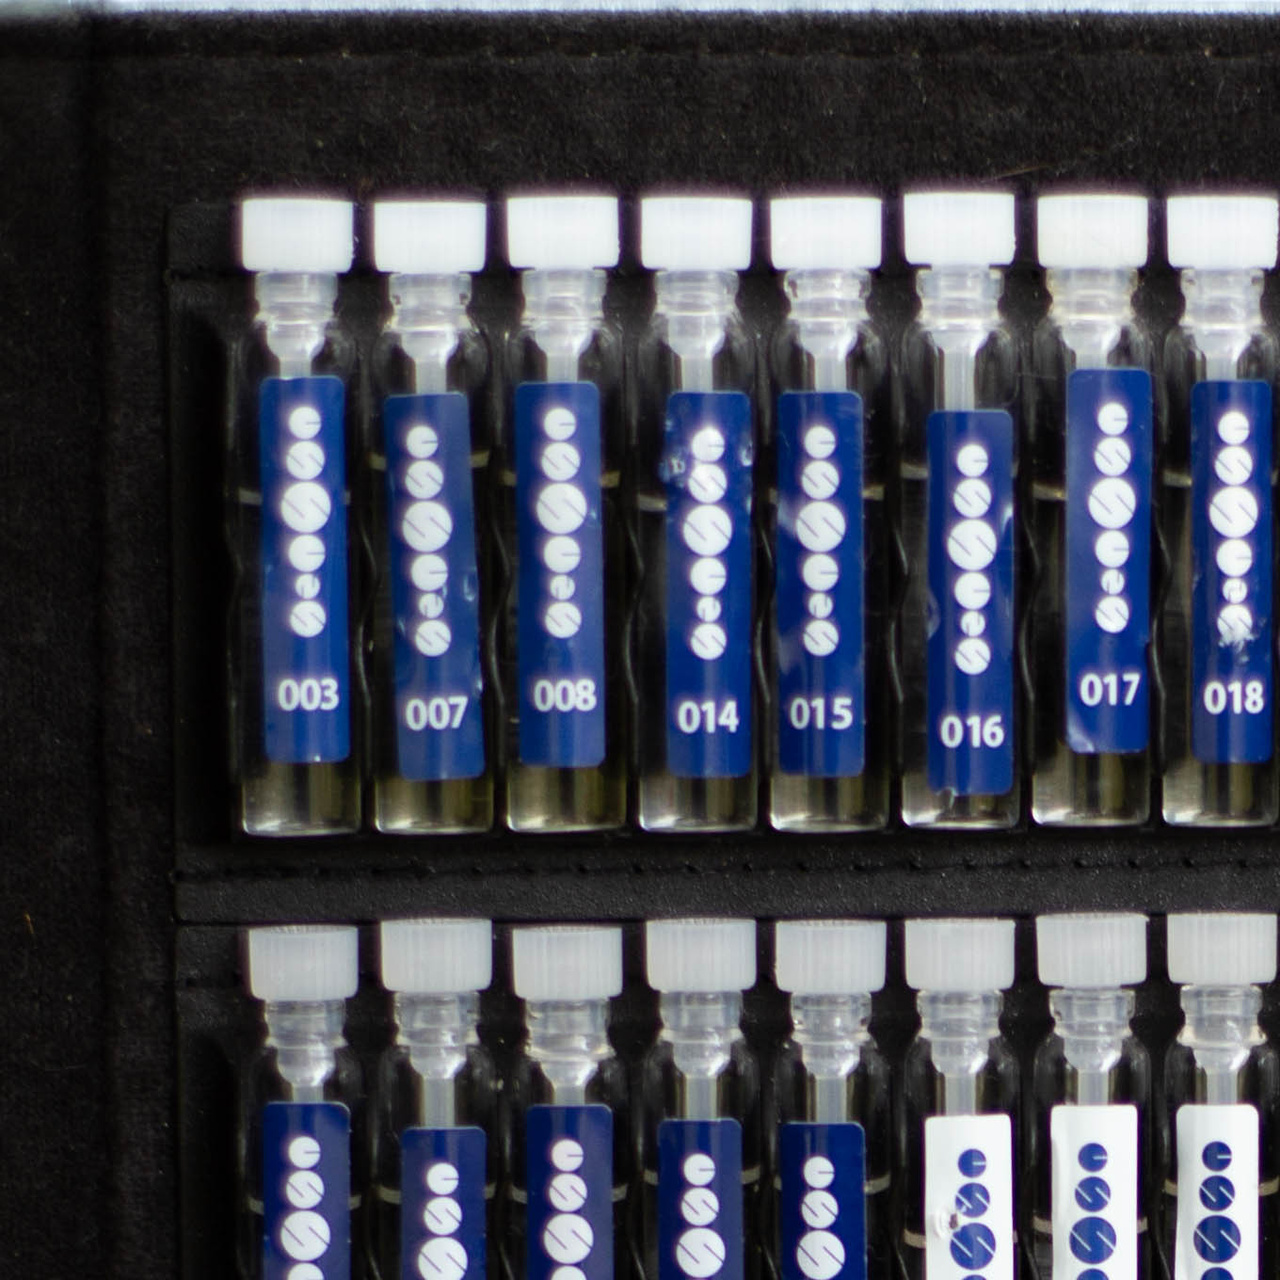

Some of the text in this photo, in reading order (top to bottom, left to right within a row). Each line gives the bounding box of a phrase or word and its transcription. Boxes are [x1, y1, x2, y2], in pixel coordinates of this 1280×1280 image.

[277, 677, 339, 711] 003
[534, 677, 597, 712] 008
[1079, 672, 1141, 706] 017
[1203, 679, 1264, 714] 018
[405, 695, 468, 731] 007
[677, 699, 739, 734] 014
[791, 695, 853, 730] 015
[940, 714, 1005, 748] 016
